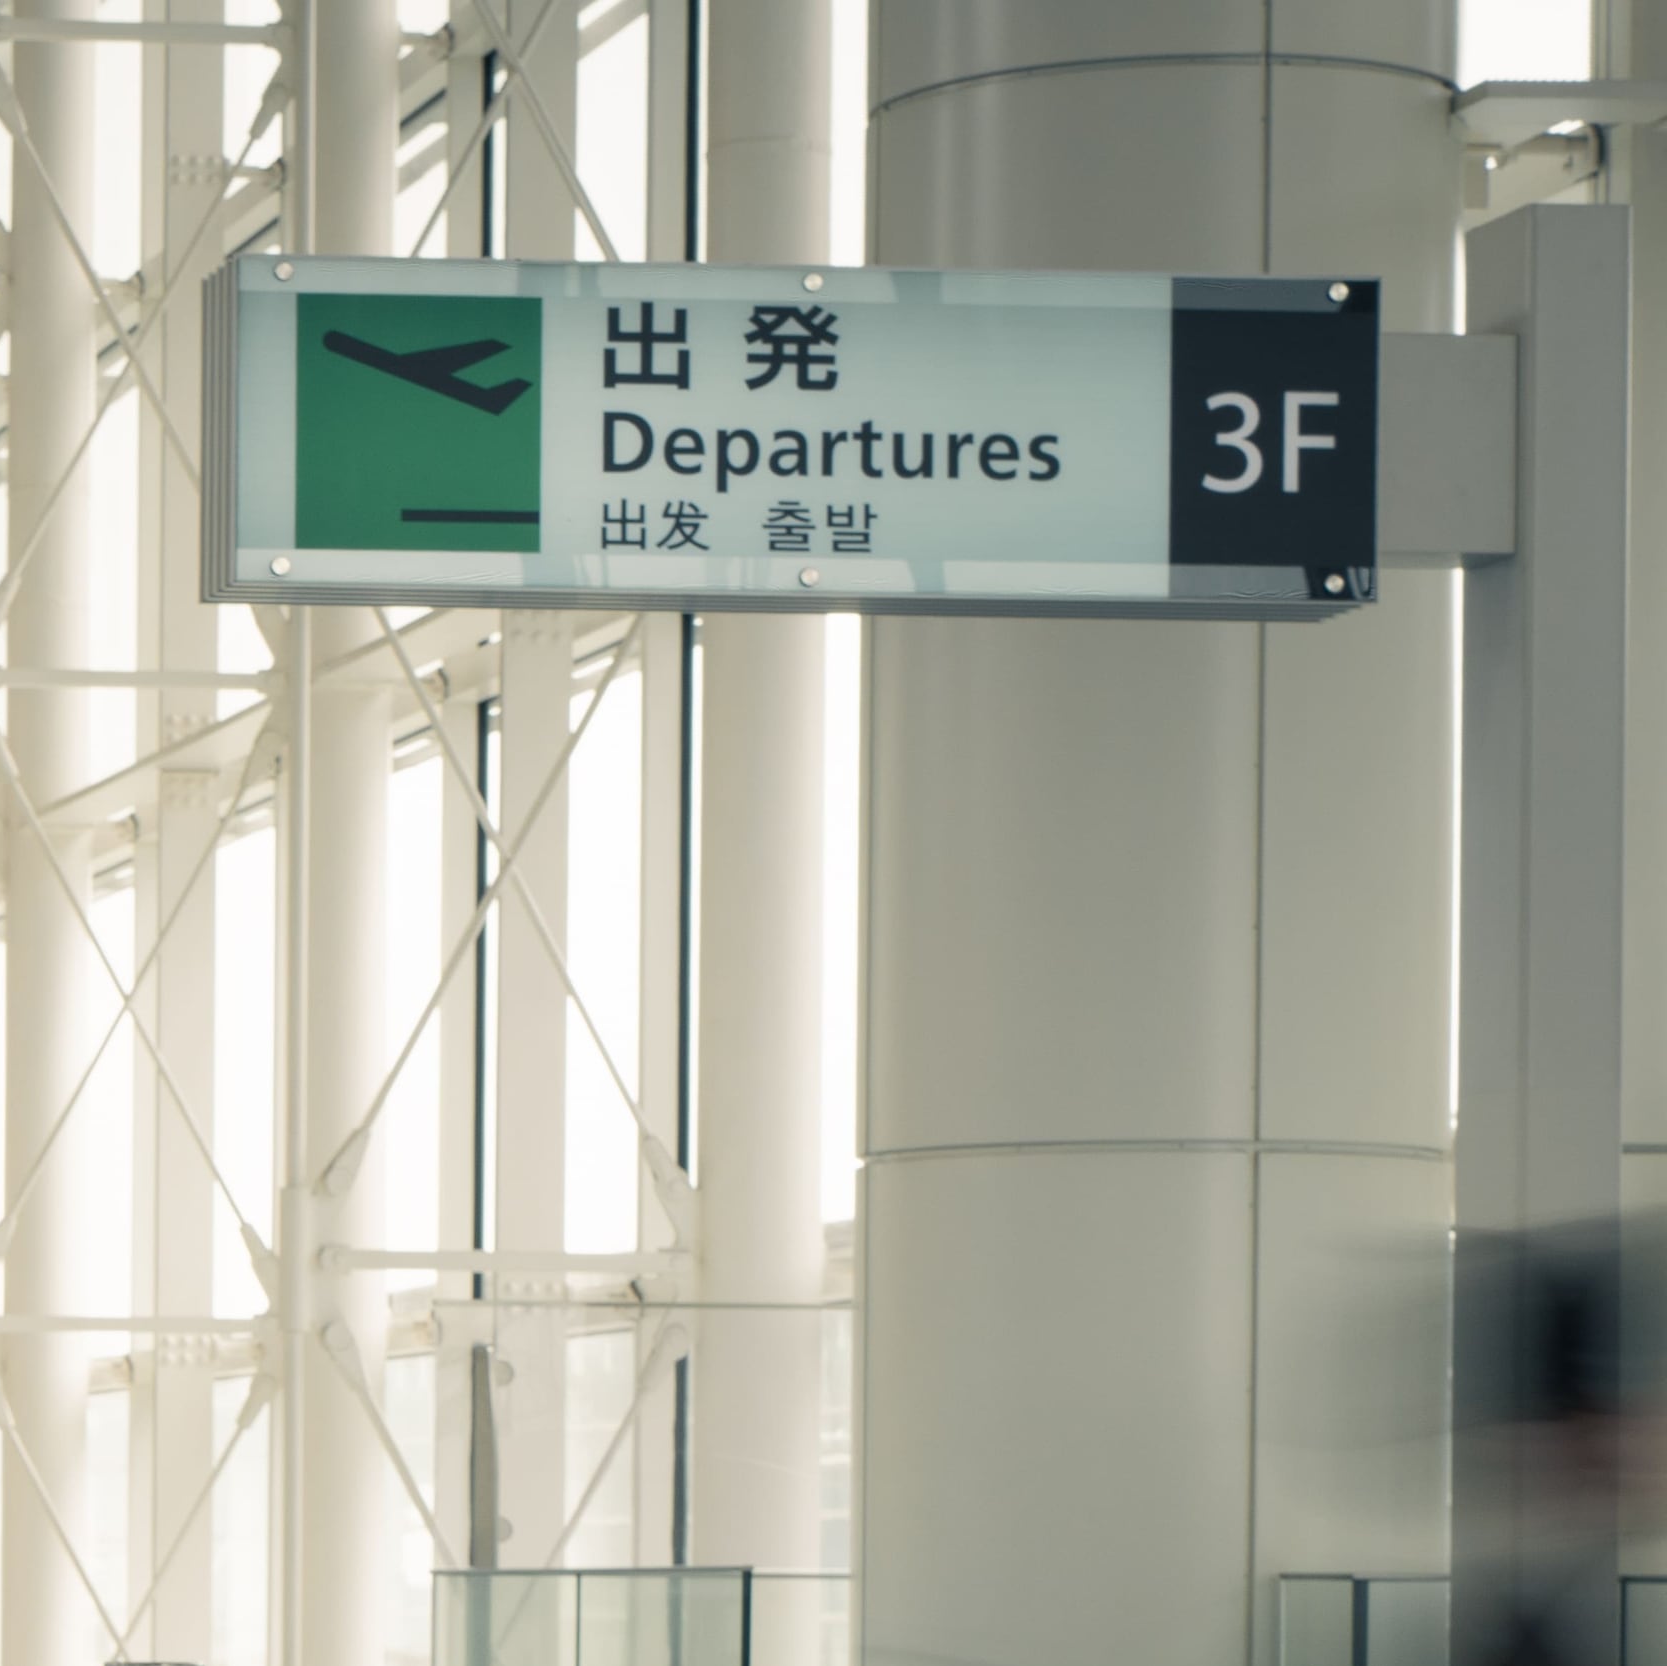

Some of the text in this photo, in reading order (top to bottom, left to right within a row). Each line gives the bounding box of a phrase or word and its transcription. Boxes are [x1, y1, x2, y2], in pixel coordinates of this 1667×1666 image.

[602, 301, 840, 392] 出発
[601, 410, 1062, 495] Departures
[1201, 390, 1340, 495] 3F
[601, 497, 711, 552] 出发
[761, 499, 879, 553] 출발
